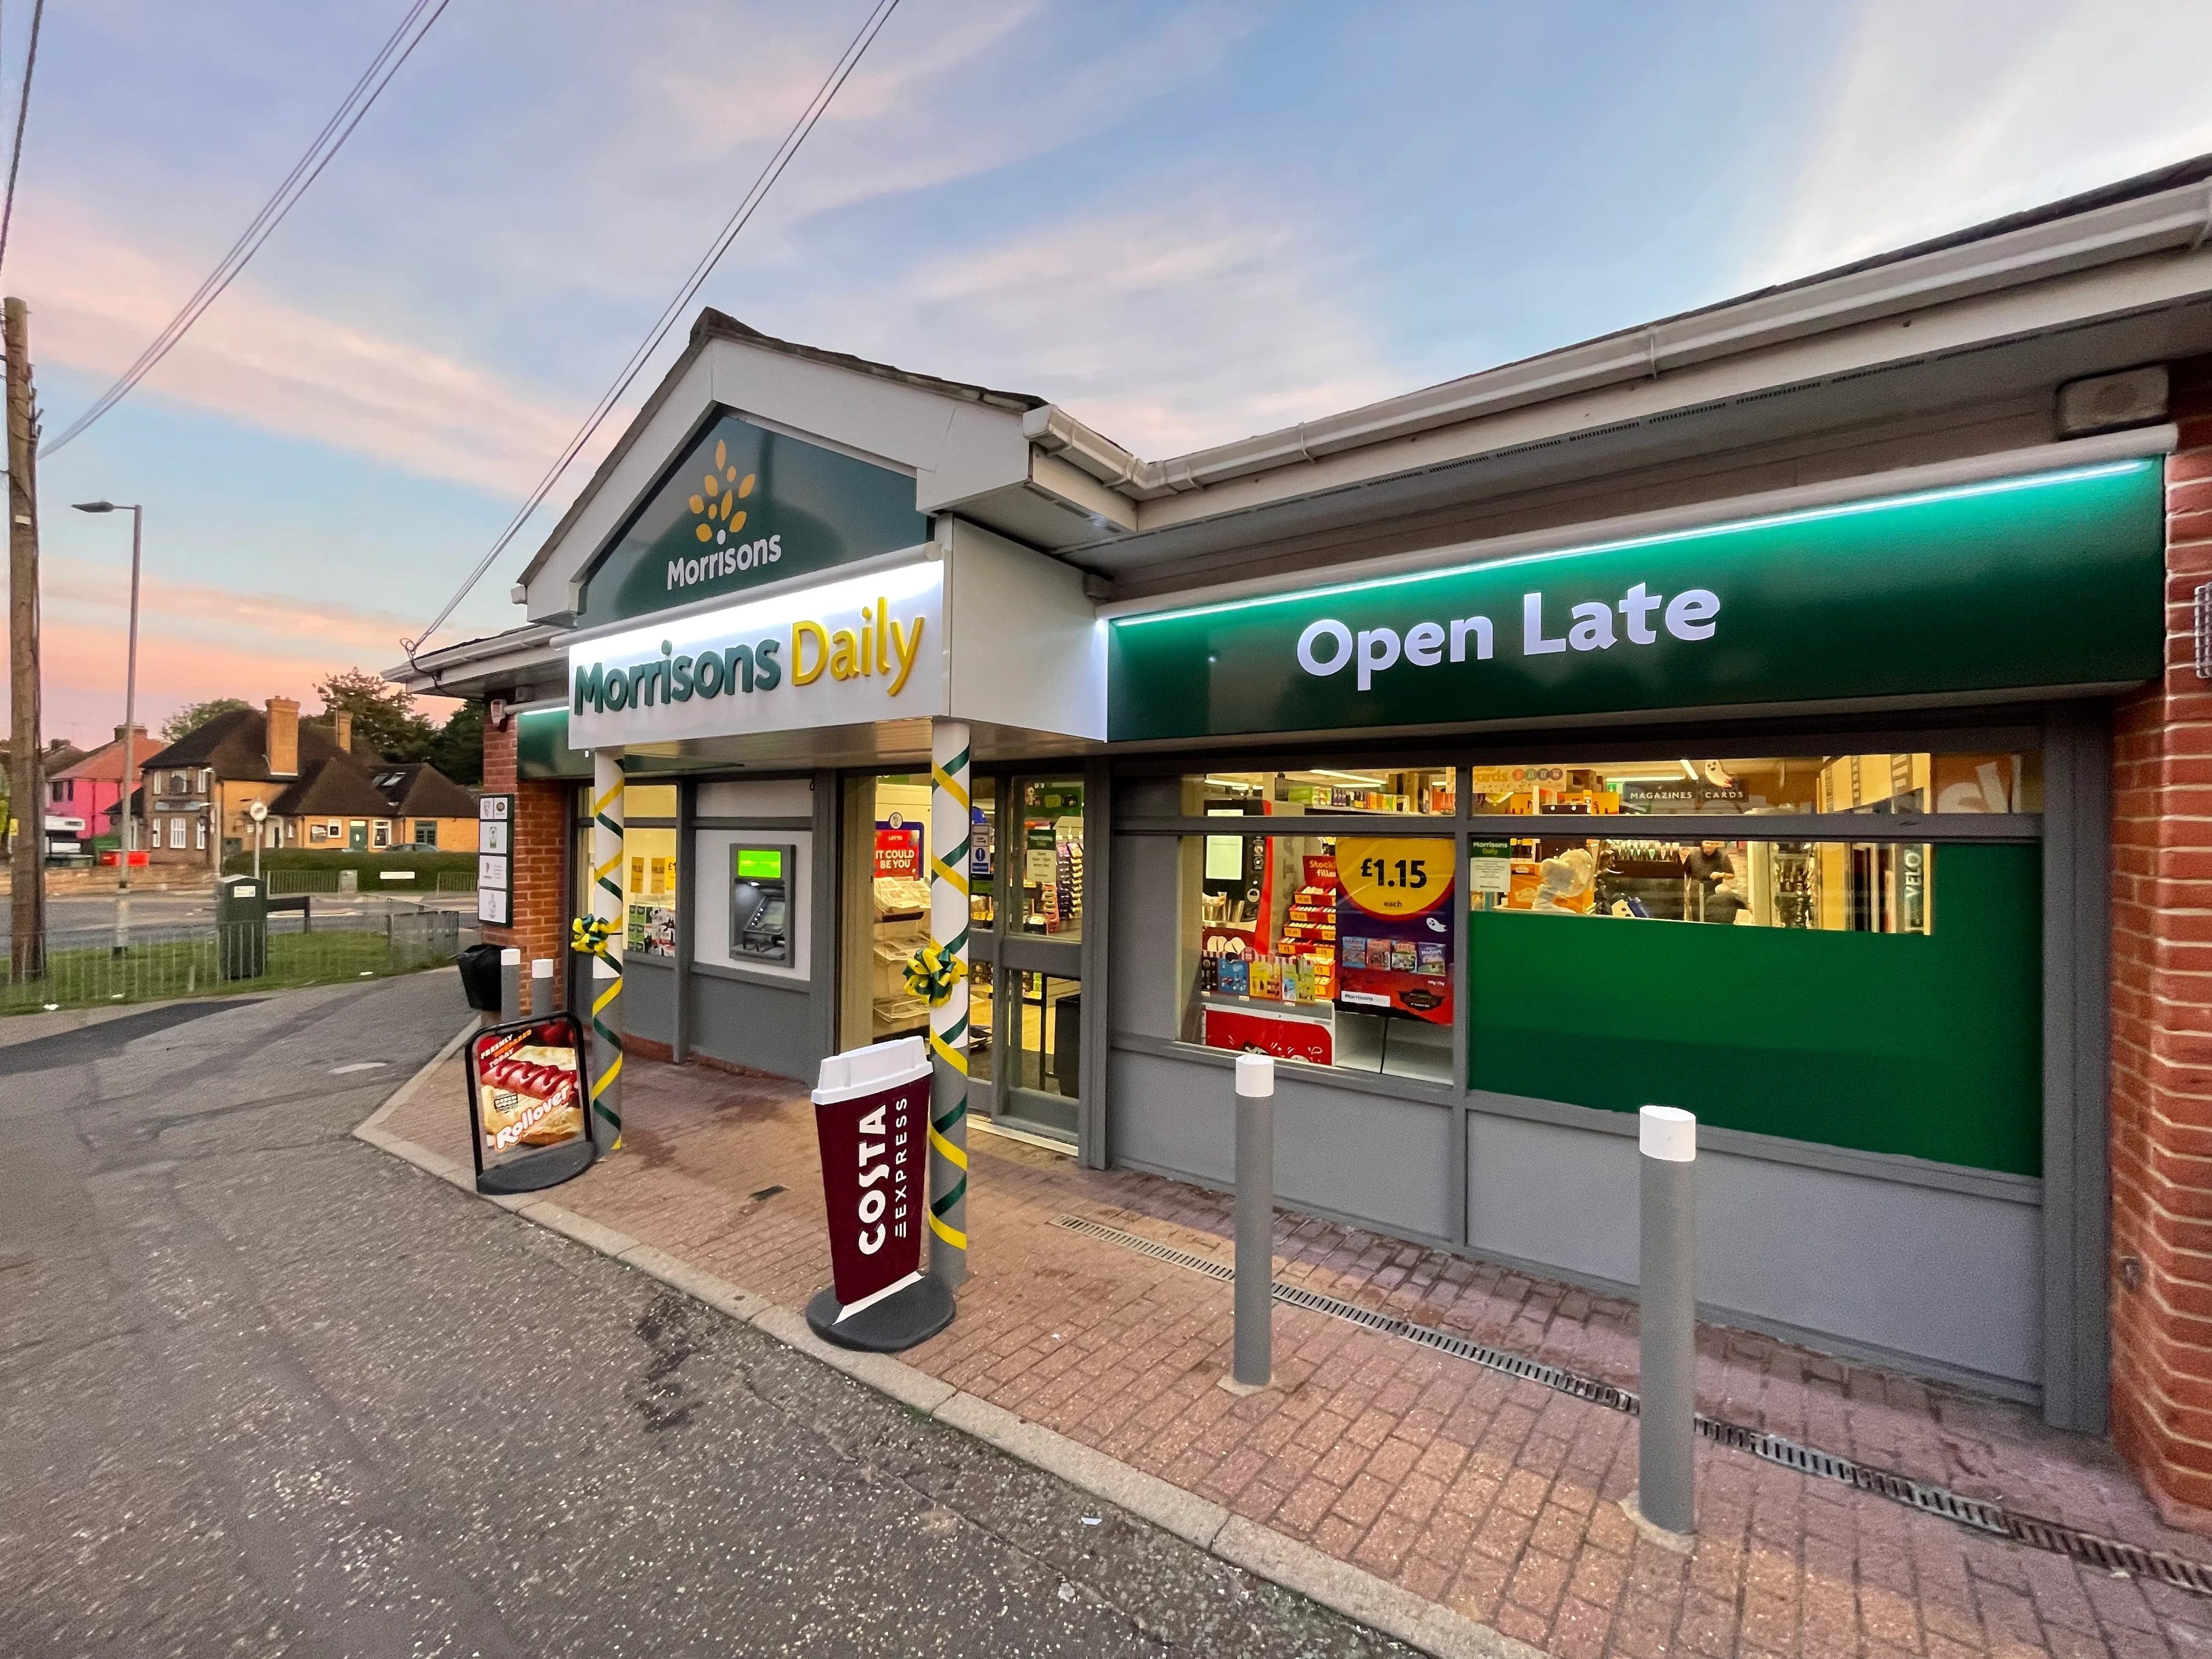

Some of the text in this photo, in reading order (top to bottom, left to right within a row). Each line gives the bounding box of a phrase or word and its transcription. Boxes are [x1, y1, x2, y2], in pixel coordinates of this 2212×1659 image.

[667, 529, 782, 590] Morrisons
[574, 596, 925, 716] Morrisons Daily
[1296, 582, 1722, 691] Open Late
[876, 849, 915, 859] IT COULD
[881, 859, 911, 870] BE YOU
[1361, 857, 1427, 889] £1.15
[1904, 851, 1922, 898] VELO
[481, 1034, 513, 1059] FRESHLY
[489, 1047, 514, 1068] TODAY
[495, 1084, 571, 1150] Rollover
[858, 1104, 889, 1255] COSTA
[895, 1098, 907, 1222] EXPRESS
